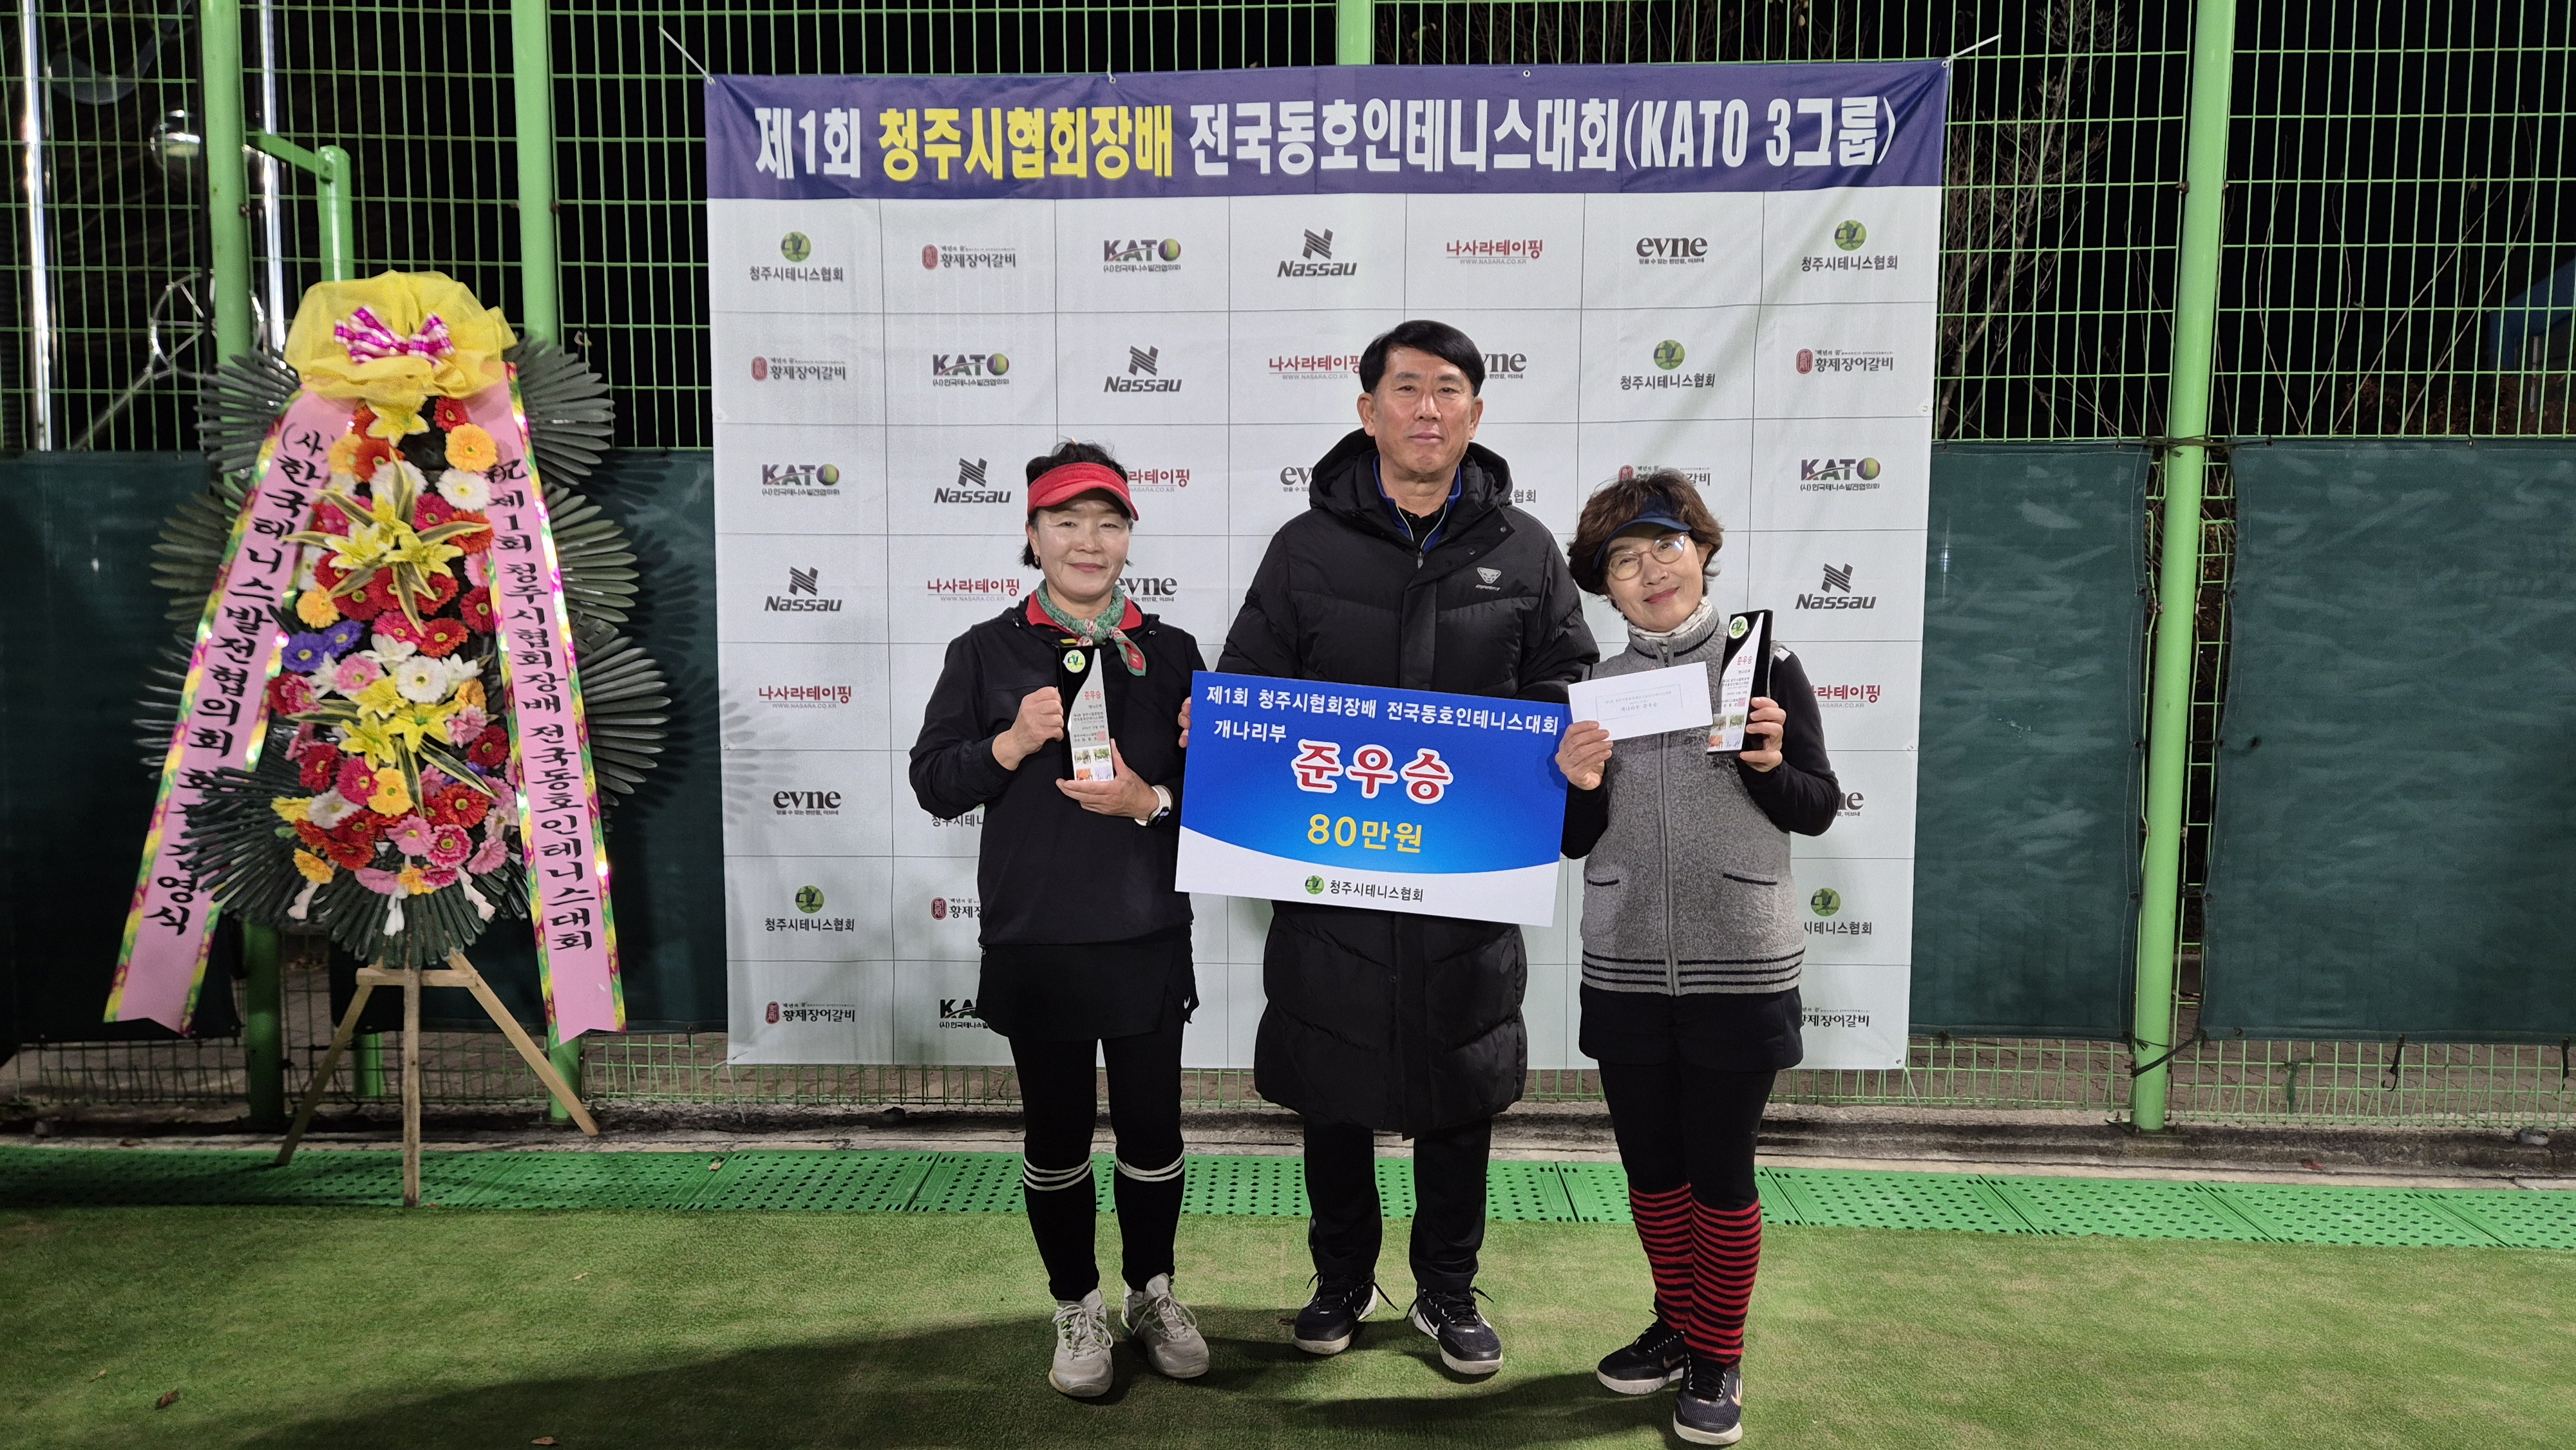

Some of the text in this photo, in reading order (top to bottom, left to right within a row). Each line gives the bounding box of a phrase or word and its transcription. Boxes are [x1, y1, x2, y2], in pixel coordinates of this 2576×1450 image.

[755, 95, 1897, 182] 제1회 청주시협회장배 전국동호인테니스대회(KATO 3그룹)
[1104, 238, 1181, 261] KATO
[1446, 239, 1543, 259] 나사라테이핑
[1636, 237, 1708, 257] evne
[940, 252, 1016, 268] 황제장어갈비
[1277, 260, 1358, 277] Nassau
[1802, 256, 1898, 271] 청주시테니스협회
[750, 267, 844, 281] 청주시테니스협회
[933, 353, 1009, 375] KATO
[1269, 355, 1359, 373] 나사라테이핑
[1483, 353, 1527, 372] ne
[1815, 357, 1893, 372] 황제장어갈비
[770, 365, 845, 380] 황제장어갈비
[1620, 373, 1716, 390] 청주시테니스협회
[1104, 377, 1182, 393] Nassau
[762, 464, 839, 485] KATO
[1280, 467, 1313, 485] ev
[1801, 457, 1880, 480] KATO
[1128, 469, 1190, 487] 라테이핑
[933, 487, 1011, 504] Nassau
[927, 578, 1020, 597] 나사라테이핑
[764, 596, 842, 612] Nassau
[1795, 593, 1877, 610] Nassau
[758, 685, 852, 704] 나사라테이핑
[1812, 684, 1881, 704] 라테이핑
[1206, 685, 1558, 735] 제1회 청주시협회장배 전국동호인테니스대회
[487, 490, 596, 952] 제1회 청주시협회장배 전국동호인테니스대회
[1213, 720, 1287, 743] 개나리부
[1291, 739, 1454, 804] 준우승
[773, 791, 842, 809] evne
[1307, 813, 1423, 853] 80만원
[1329, 880, 1424, 902] 청주시테니스협회
[949, 905, 981, 918] 황제장
[765, 918, 855, 932] 청주시테니스협회
[1804, 921, 1872, 935] 시테니스협회
[782, 1009, 855, 1022] 황제장어갈비
[940, 999, 976, 1019] KA
